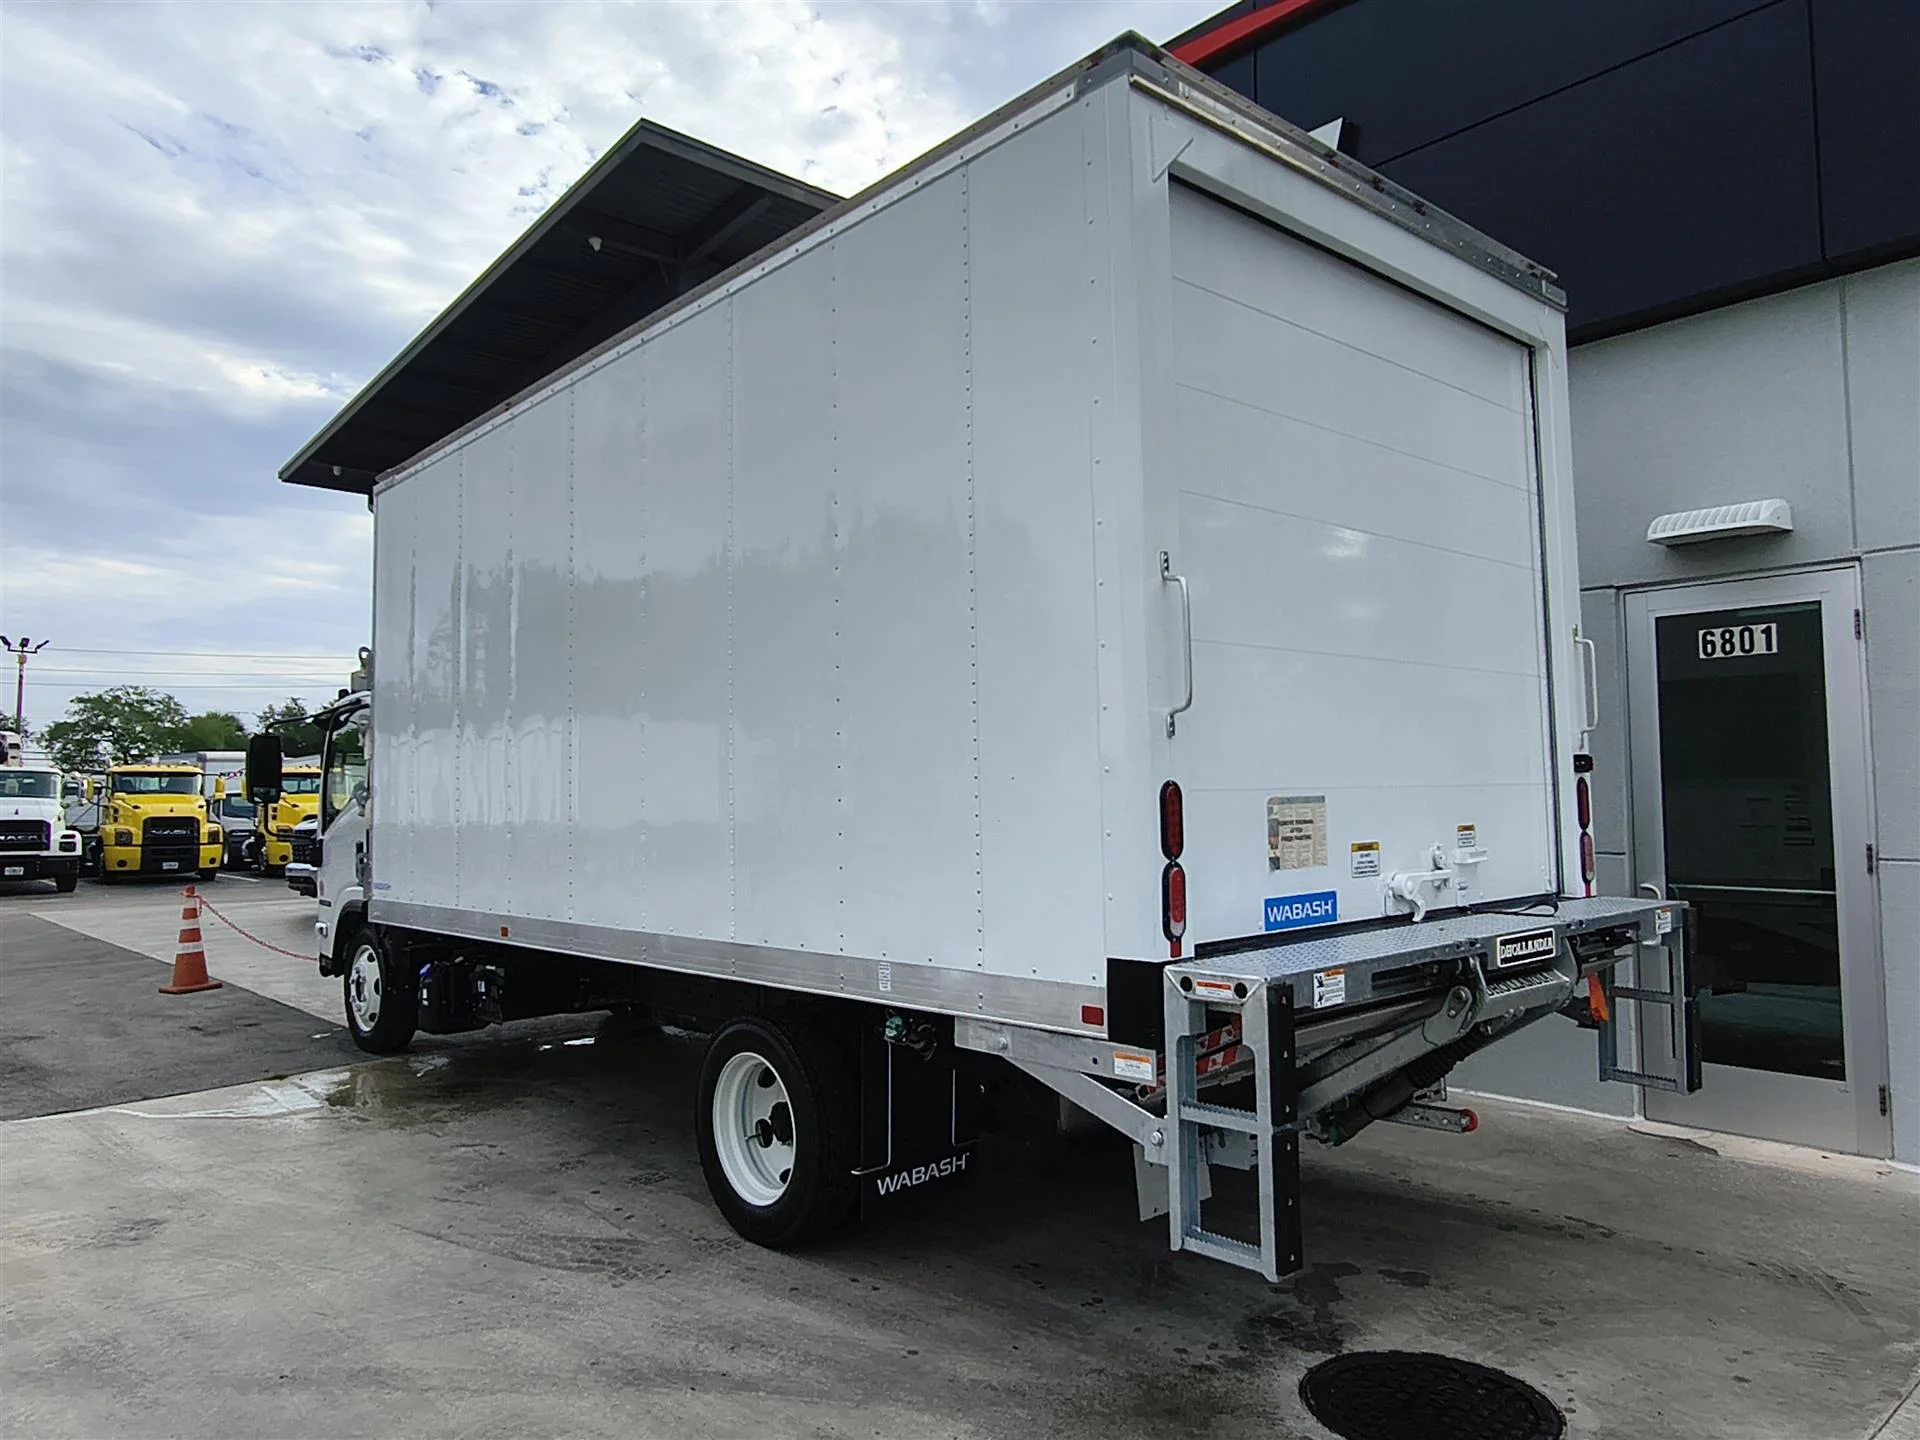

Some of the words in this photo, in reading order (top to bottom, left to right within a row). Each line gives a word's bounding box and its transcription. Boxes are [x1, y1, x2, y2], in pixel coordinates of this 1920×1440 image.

[1702, 625, 1773, 657] 6801
[1268, 900, 1332, 923] WABASH
[1500, 937, 1553, 959] DHOLLANDIA
[877, 1153, 967, 1196] WABASH
